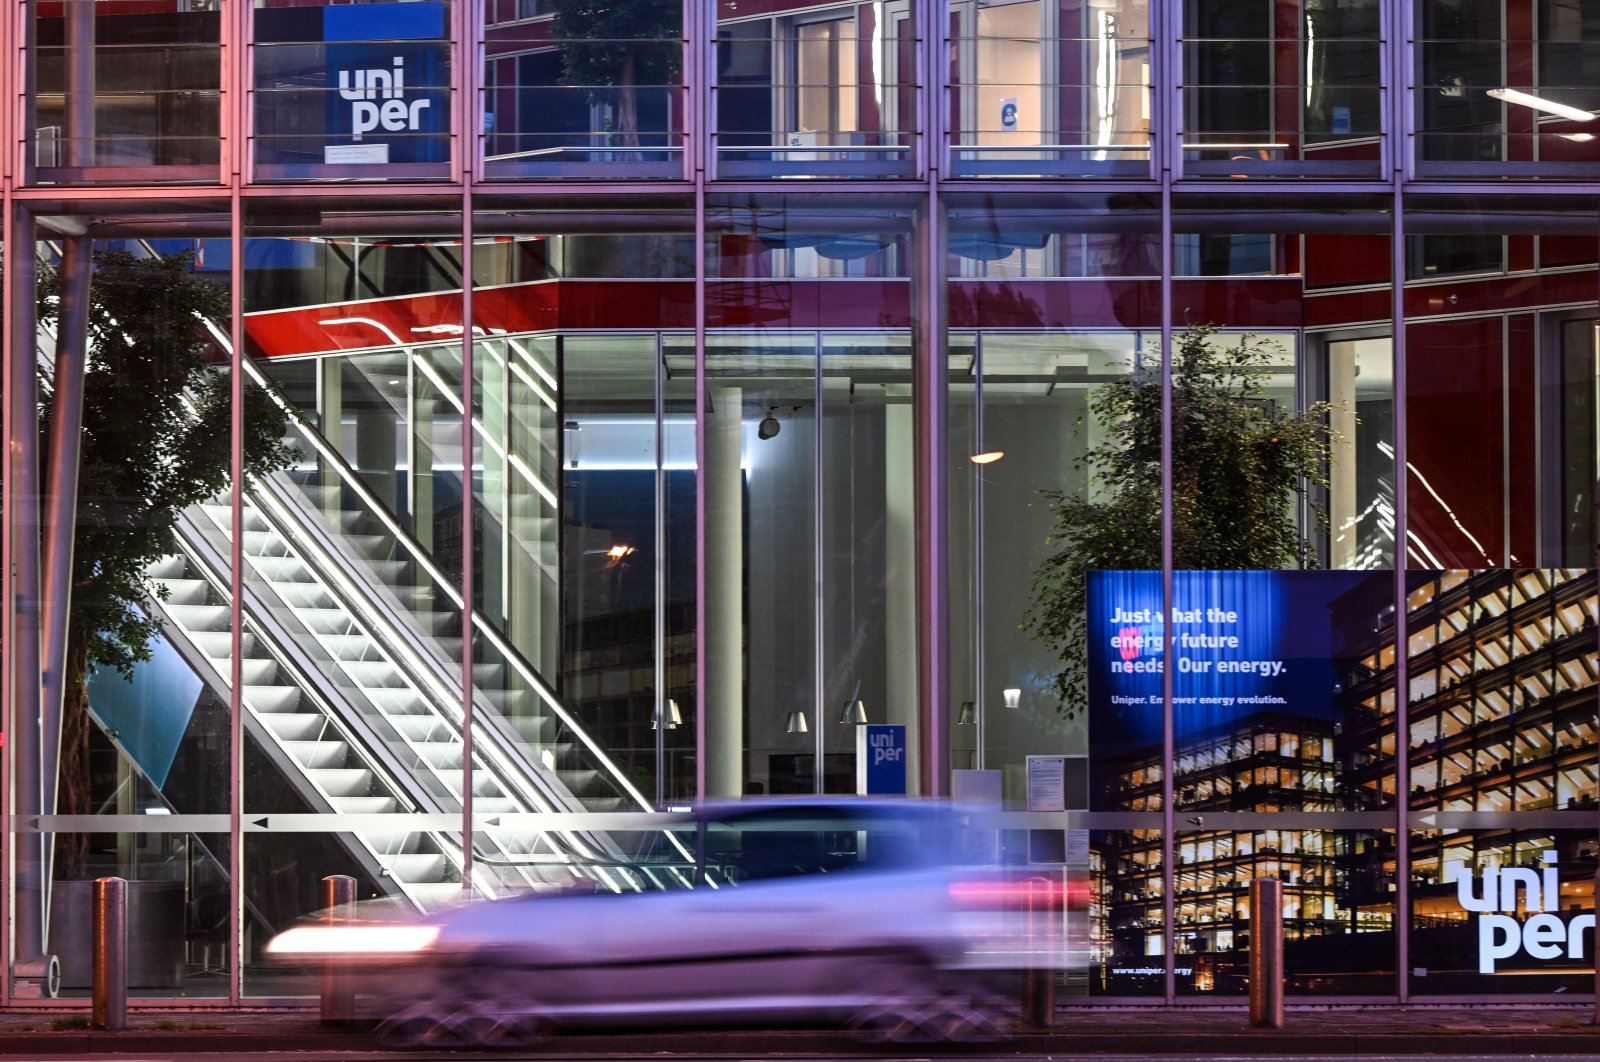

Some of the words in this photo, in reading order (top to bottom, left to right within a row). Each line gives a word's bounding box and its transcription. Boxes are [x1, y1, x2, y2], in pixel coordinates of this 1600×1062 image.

[339, 56, 404, 100] uni
[352, 99, 431, 141] per
[1110, 607, 1151, 623] Just
[1207, 607, 1238, 623] the
[1181, 632, 1239, 648] future
[1177, 657, 1212, 673] Our
[1216, 661, 1287, 677] energy.
[1111, 695, 1148, 706] Uniper.
[1150, 695, 1197, 705] Emower
[1199, 697, 1235, 706] energy
[1237, 694, 1287, 705] evolution.
[870, 729, 894, 748] uni
[874, 747, 904, 765] per
[1457, 850, 1559, 912] uni
[1479, 913, 1596, 974] per
